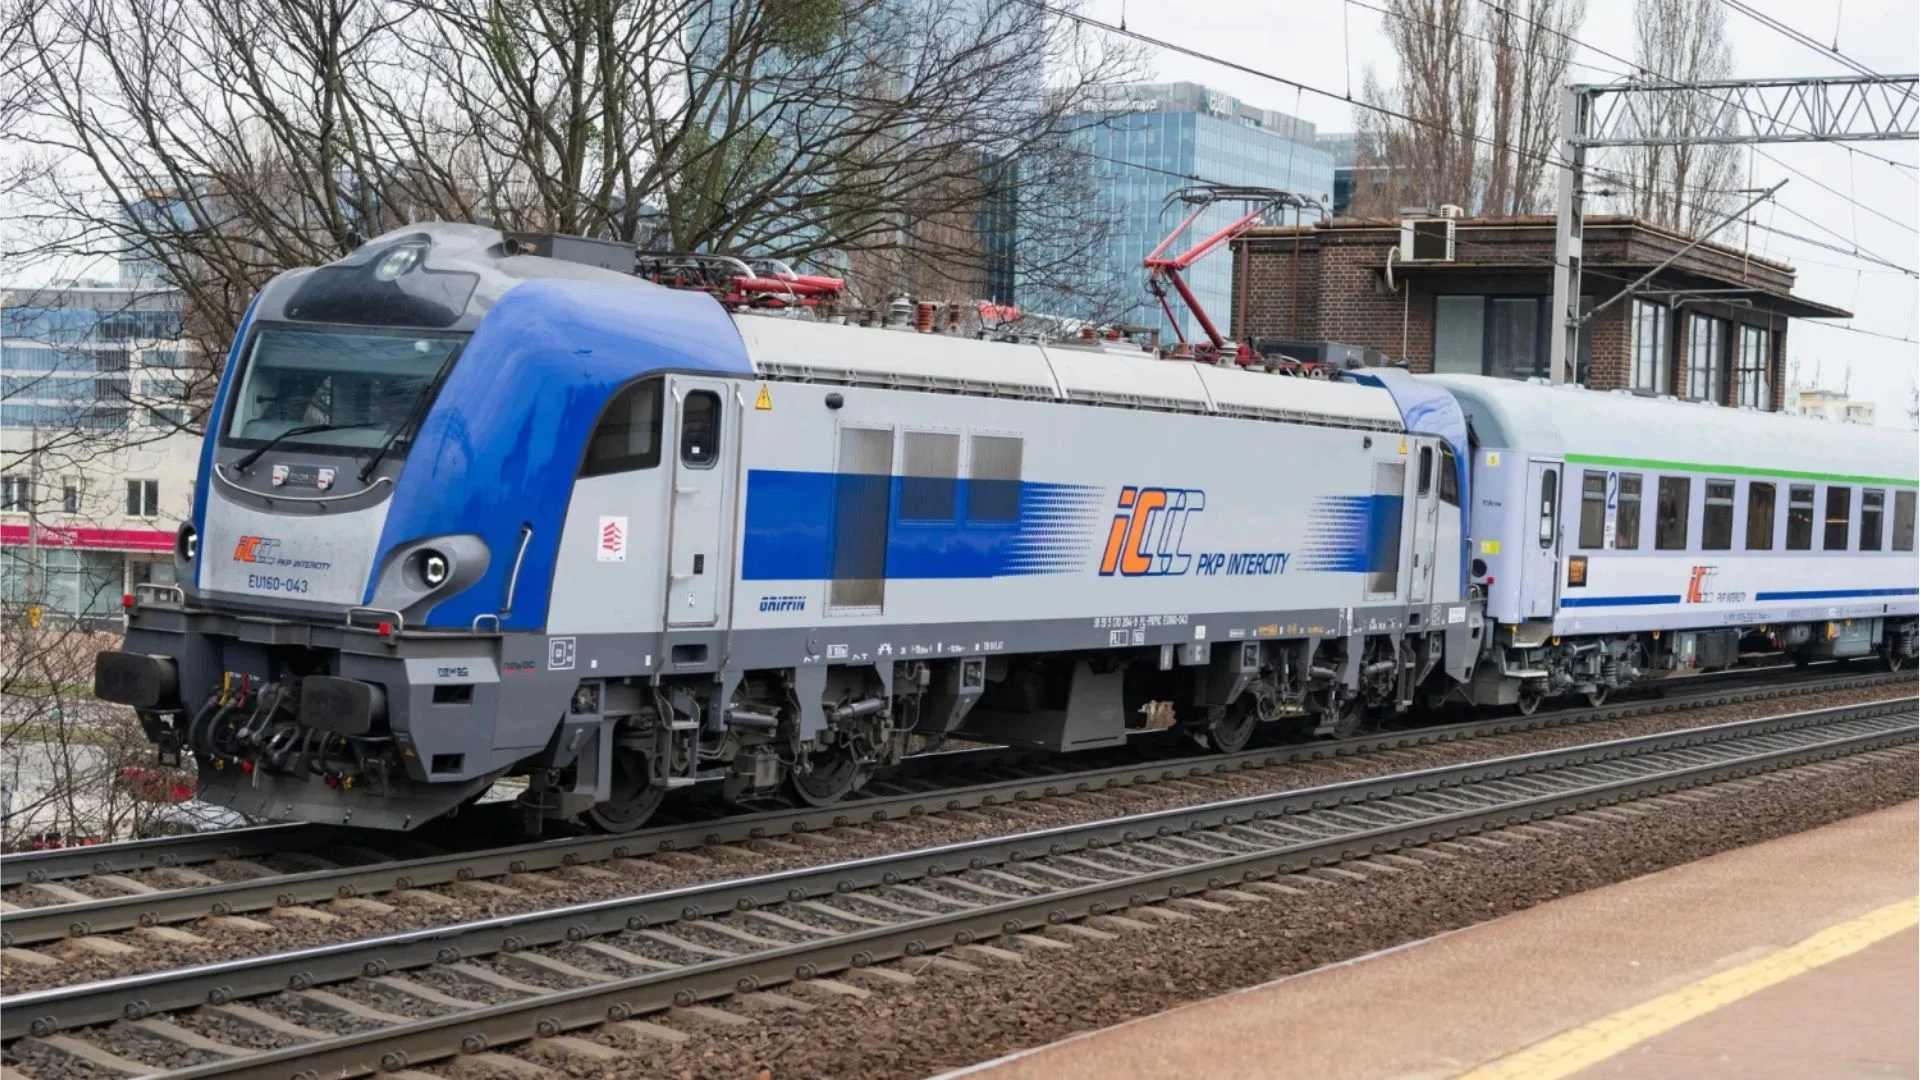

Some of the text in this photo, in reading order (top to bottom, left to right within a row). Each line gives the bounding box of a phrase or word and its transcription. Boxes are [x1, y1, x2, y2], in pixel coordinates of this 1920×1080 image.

[1607, 472, 1617, 509] 2
[276, 558, 332, 571] PKP INTERCITY
[1196, 553, 1291, 575] PKP INTERCITY
[248, 574, 309, 593] EU160-043
[760, 596, 806, 611] GRIFFIN
